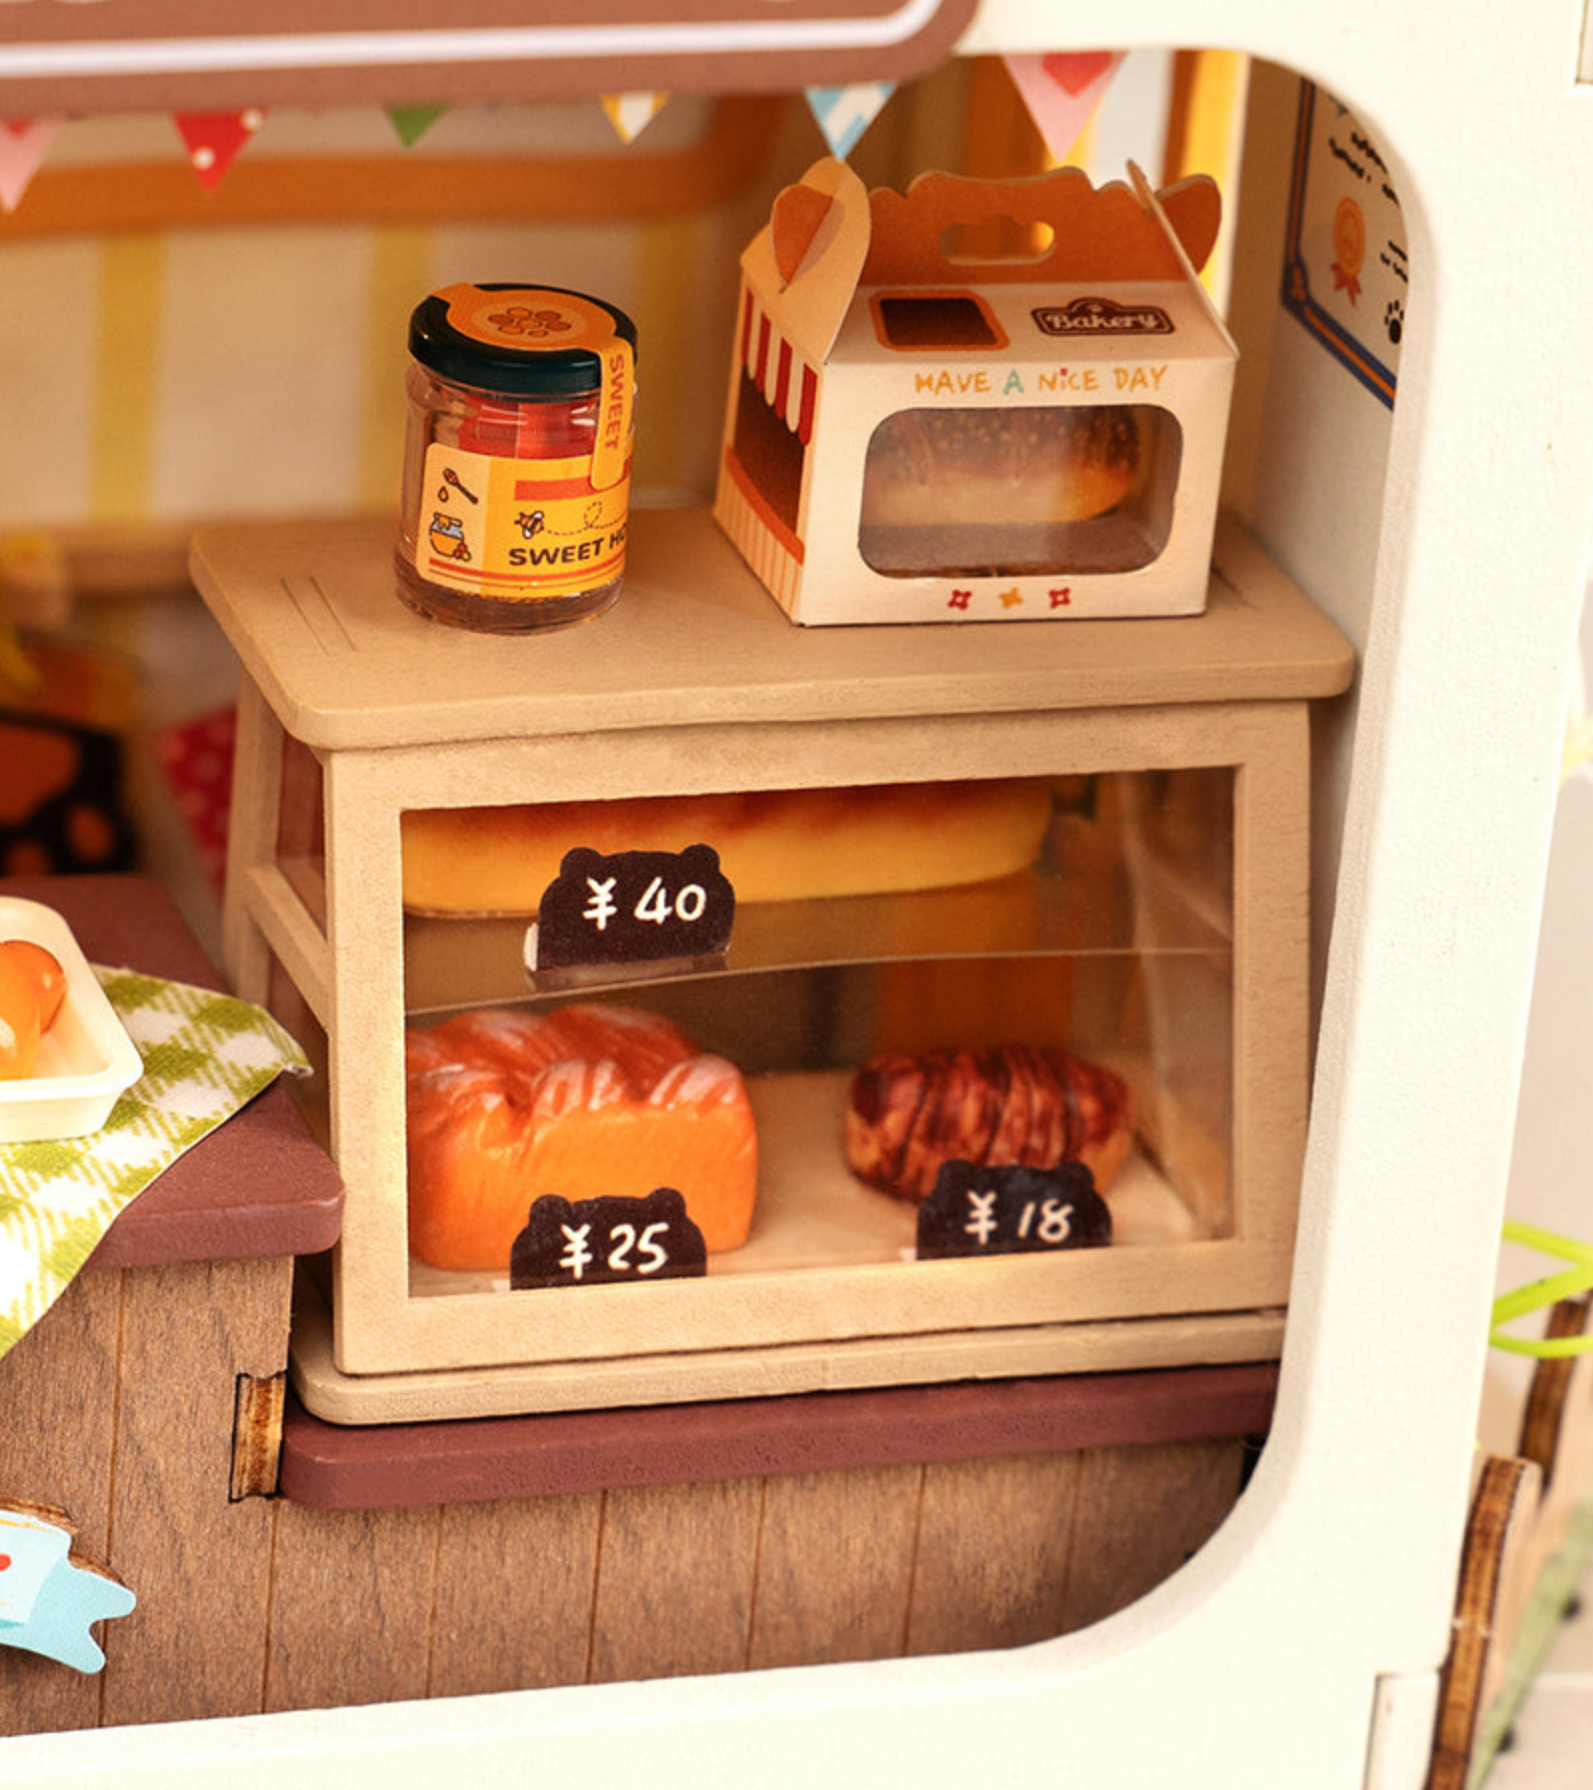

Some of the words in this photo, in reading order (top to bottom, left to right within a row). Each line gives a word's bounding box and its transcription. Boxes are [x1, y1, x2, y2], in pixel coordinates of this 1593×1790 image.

[1045, 313, 1160, 331] Bakery
[914, 370, 992, 396] HAVE
[1003, 368, 1025, 396] A
[1113, 364, 1169, 394] DAY
[605, 353, 626, 451] SWEET
[508, 536, 605, 567] SWEET
